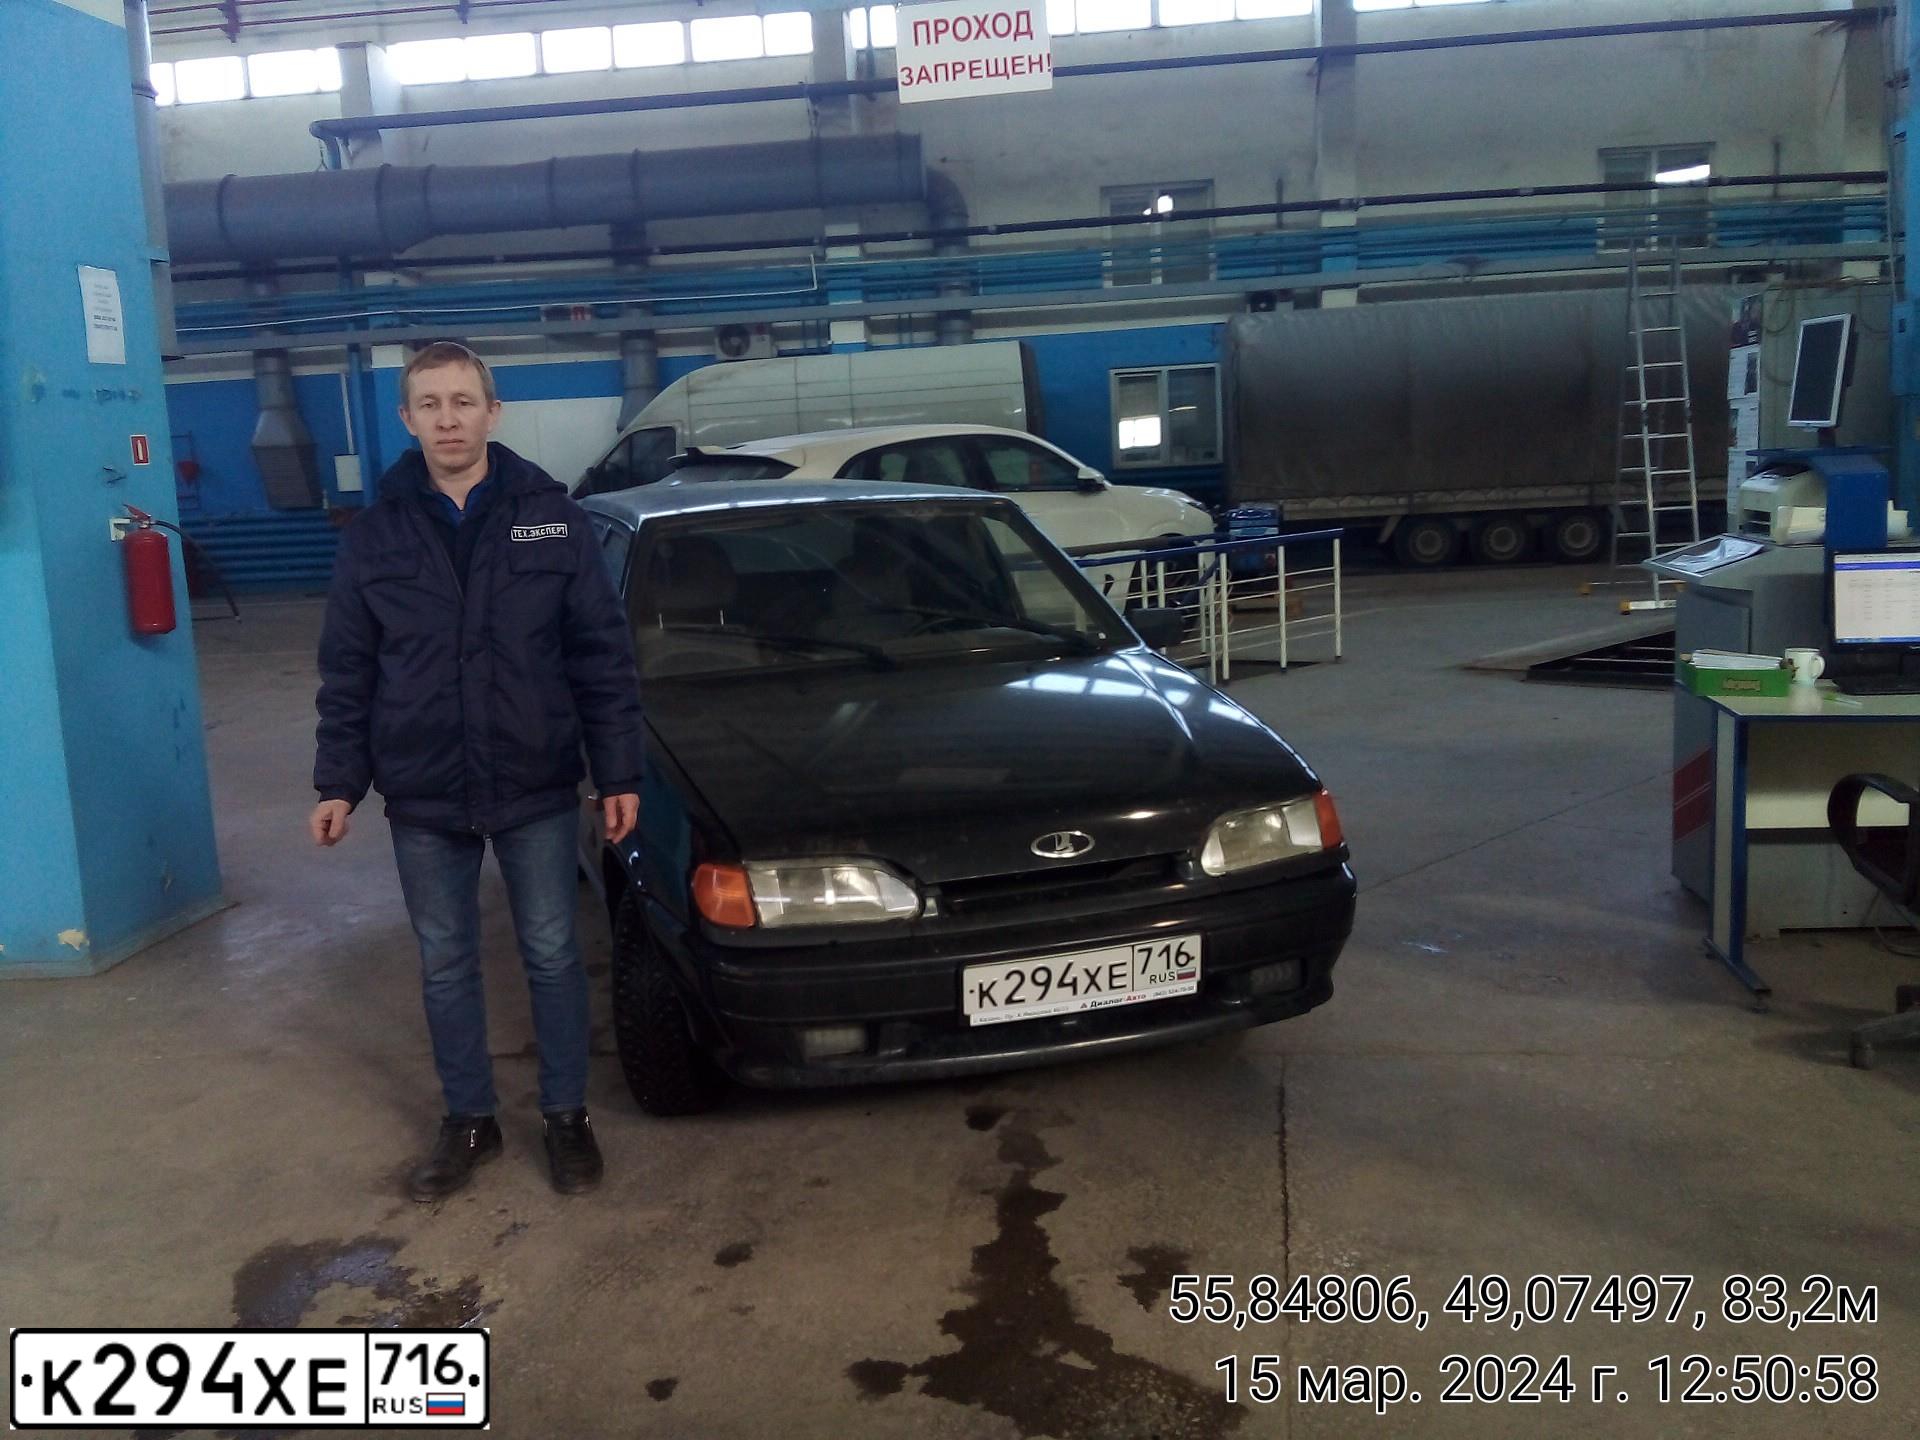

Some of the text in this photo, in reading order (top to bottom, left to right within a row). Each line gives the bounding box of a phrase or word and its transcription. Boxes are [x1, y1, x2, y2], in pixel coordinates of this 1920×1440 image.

[913, 10, 1033, 47] ПРОХОД
[900, 53, 1052, 86] ЗАПРЕЩЕН!
[978, 941, 1191, 1009] К294ХЕ 716
[1149, 971, 1177, 985] RUS
